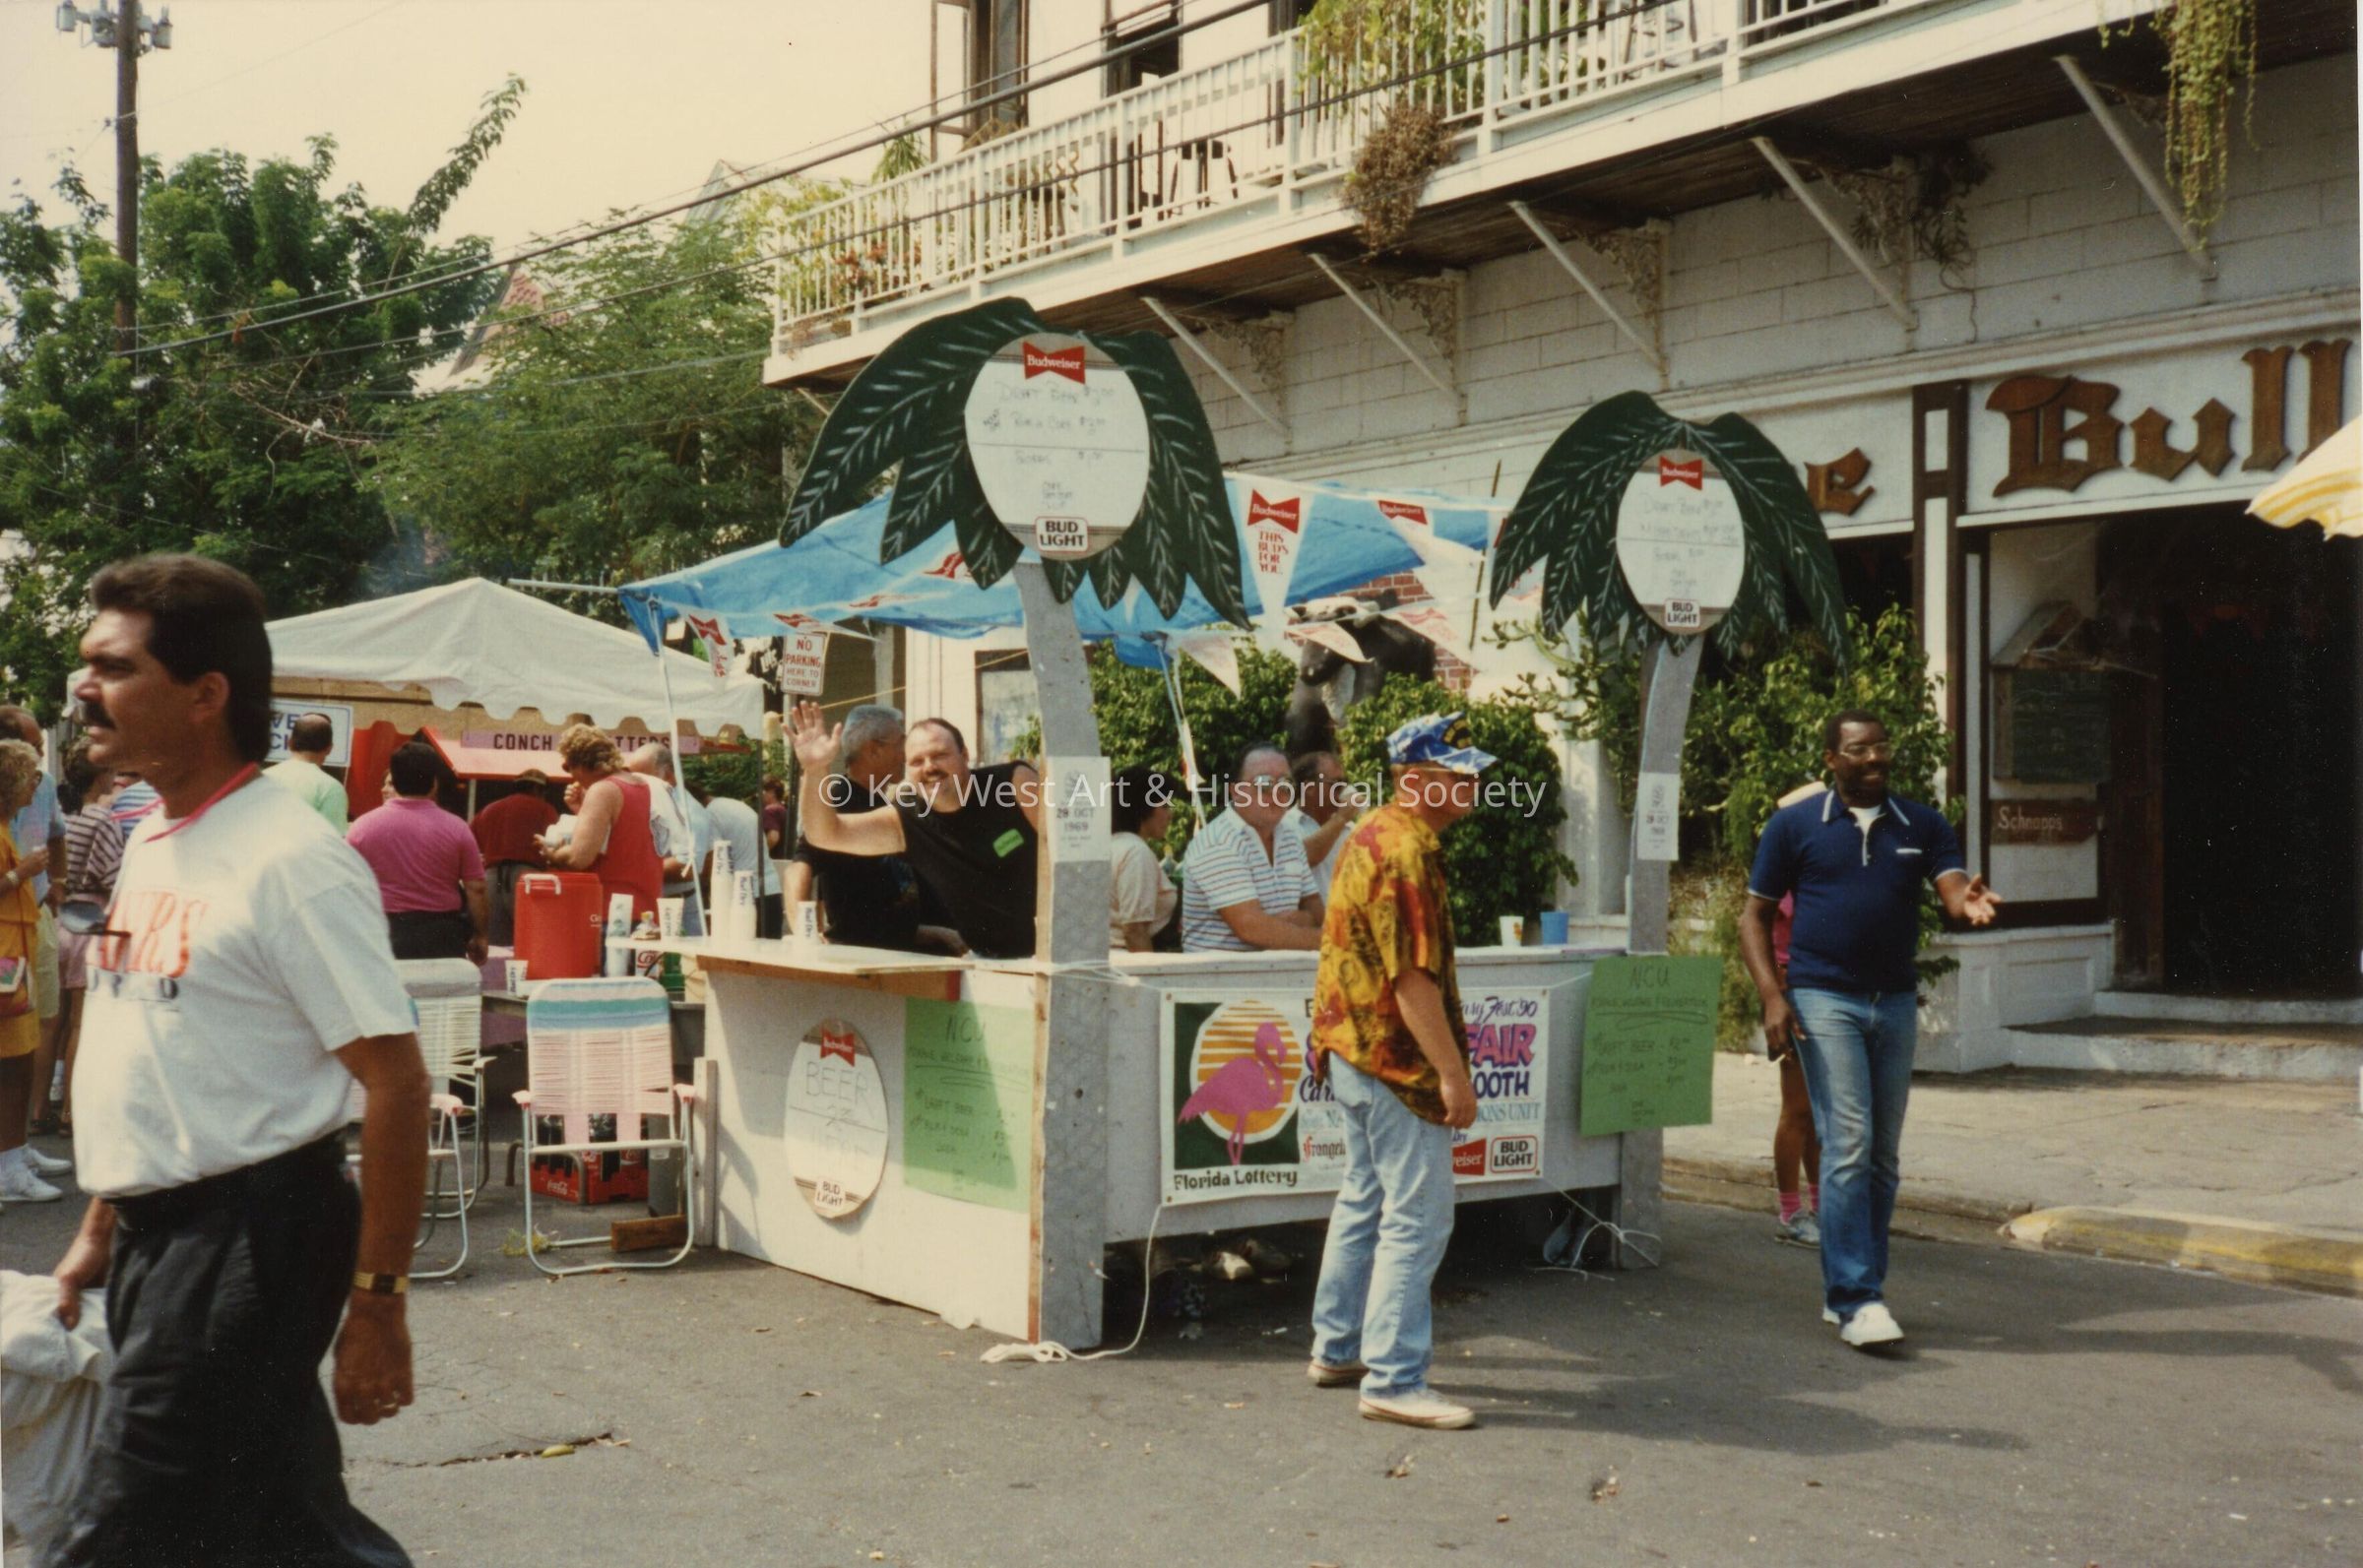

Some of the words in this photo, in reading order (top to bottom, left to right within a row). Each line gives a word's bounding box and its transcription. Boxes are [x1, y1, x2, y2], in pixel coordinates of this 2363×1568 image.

[1026, 353, 1082, 371] Budweiser
[1985, 338, 2353, 498] Bull
[1045, 520, 1079, 533] BUD
[1039, 534, 1085, 547] LIGHT
[1671, 601, 1693, 613] BUD
[1667, 613, 1698, 624] LIGHT
[796, 639, 813, 652] NO
[786, 653, 821, 668] PARKING
[809, 669, 819, 679] TO
[493, 733, 552, 751] CONCH
[1998, 806, 2063, 837] Schnapps
[1465, 1023, 1538, 1069] FAIR
[805, 1060, 875, 1120] BEER
[1473, 1070, 1531, 1099] OOTH
[1507, 1101, 1542, 1122] UNIT
[1500, 1140, 1529, 1154] BUD
[1454, 1153, 1484, 1167] eiser
[1494, 1153, 1534, 1167] LIGHT
[1174, 1170, 1231, 1191] Florida
[1234, 1168, 1298, 1187] Lottery
[821, 1181, 842, 1196] BUD
[816, 1192, 843, 1207] LIGHT
